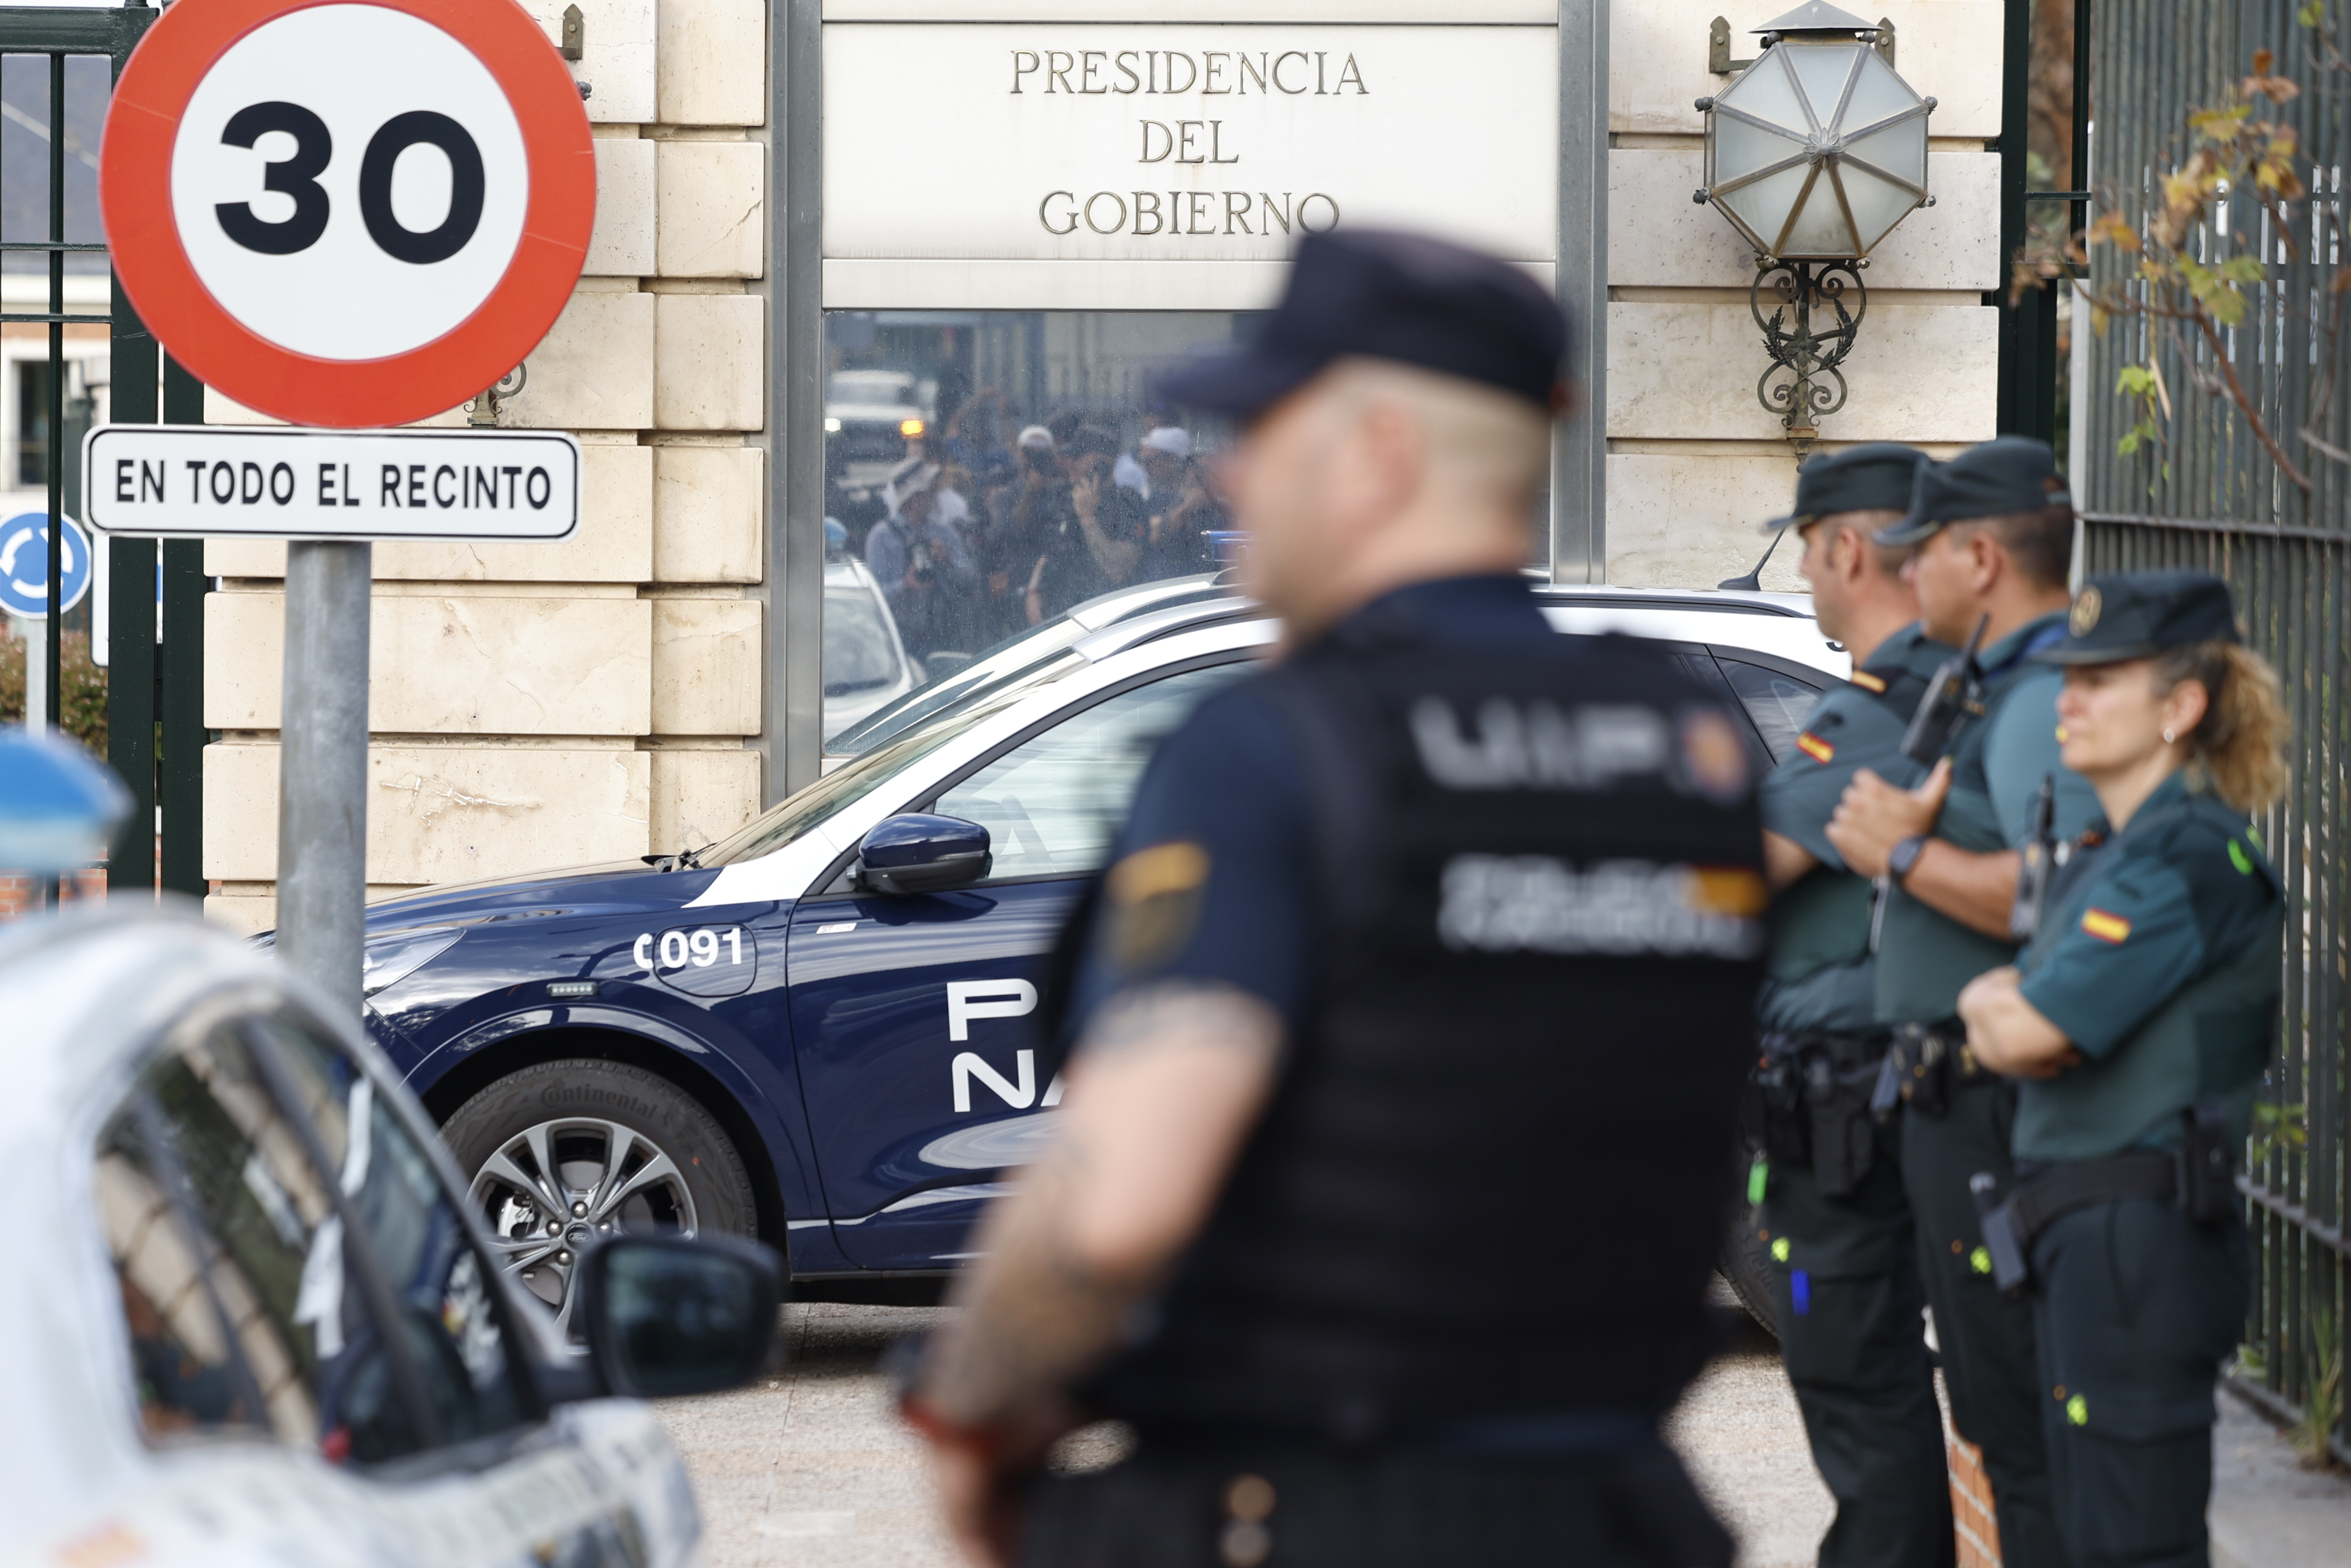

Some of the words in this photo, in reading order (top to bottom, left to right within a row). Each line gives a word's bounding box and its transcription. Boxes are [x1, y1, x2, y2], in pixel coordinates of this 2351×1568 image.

[1010, 50, 1370, 95] PRESIDENCIA
[1138, 119, 1239, 164] DEL
[215, 101, 485, 265] 30
[1039, 190, 1340, 236] GOBIERNO
[117, 459, 164, 503] EN
[186, 461, 295, 506] TODO
[319, 463, 359, 507] EL
[382, 464, 551, 510] RECINTO
[659, 927, 742, 969] 091
[540, 1084, 658, 1119] Continental
